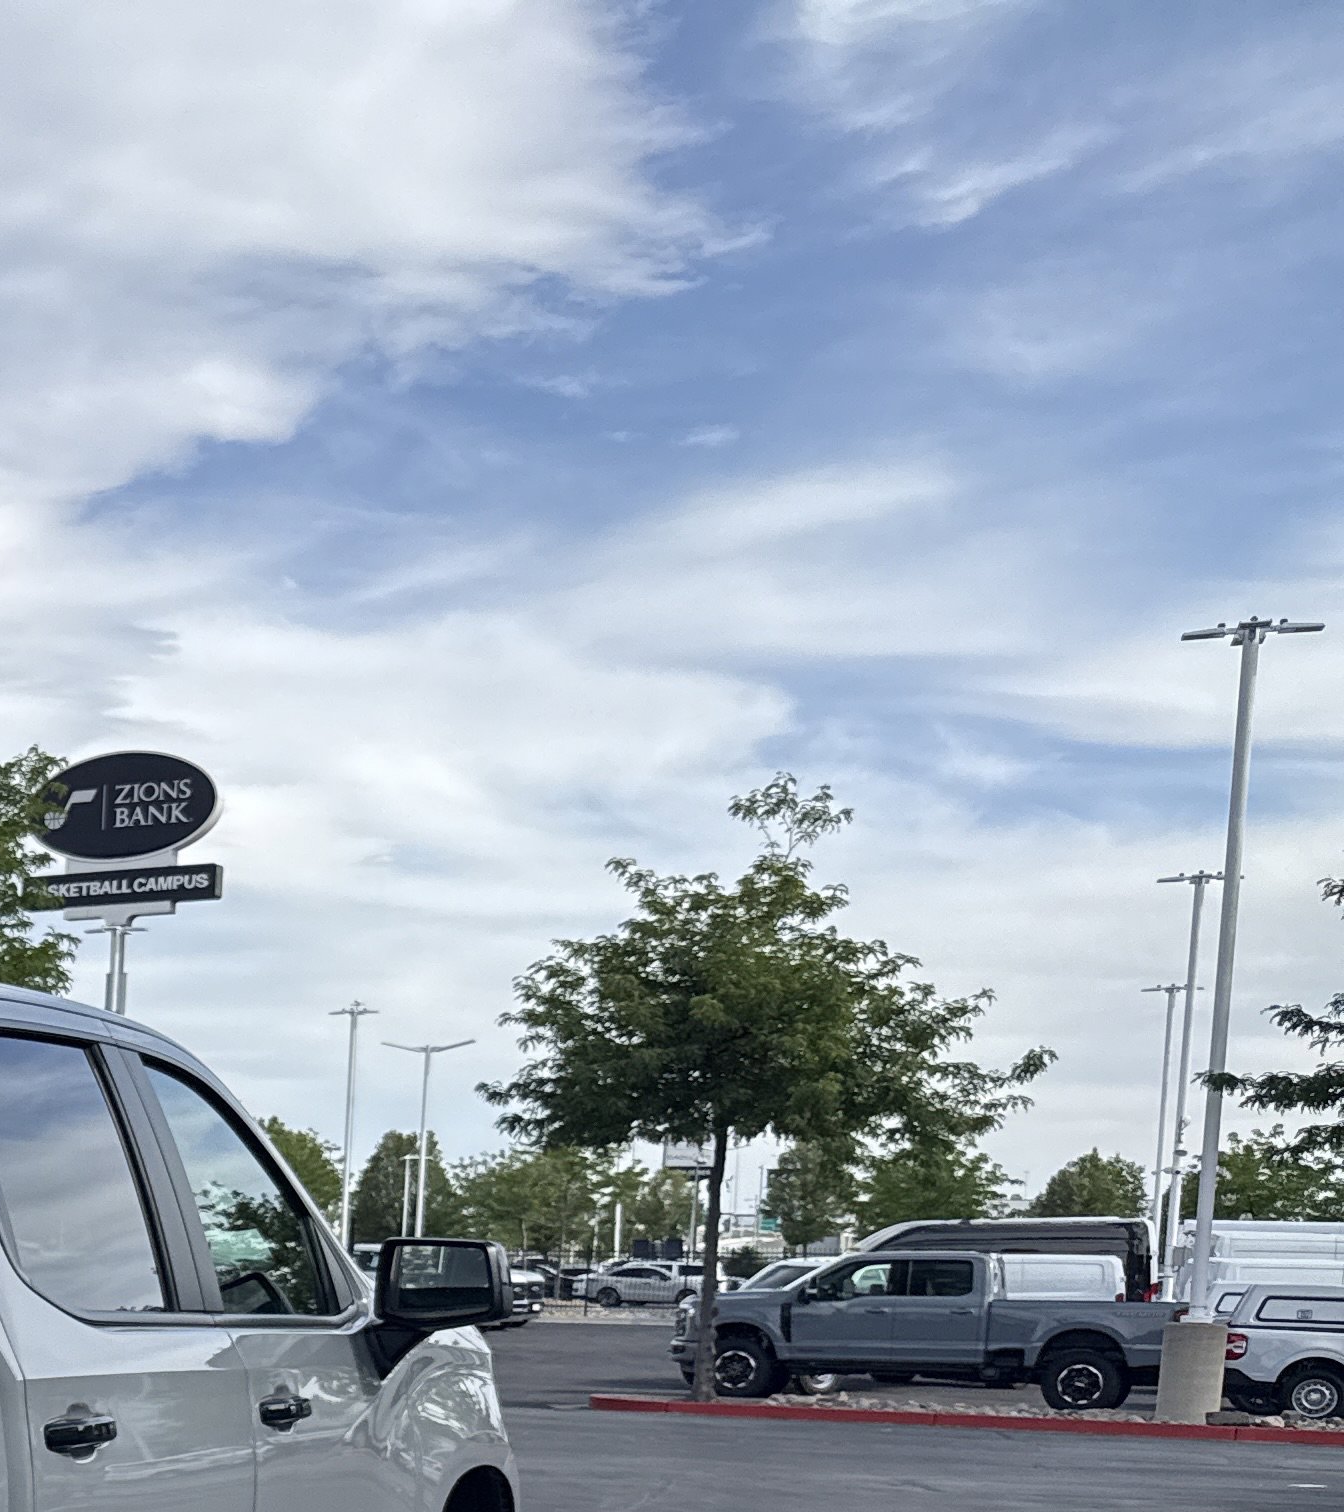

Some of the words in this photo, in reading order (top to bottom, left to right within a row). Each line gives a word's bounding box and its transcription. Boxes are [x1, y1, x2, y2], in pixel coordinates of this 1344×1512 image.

[114, 779, 192, 804] ZIONS
[114, 802, 190, 828] BANK
[133, 873, 209, 893] CAMPUS
